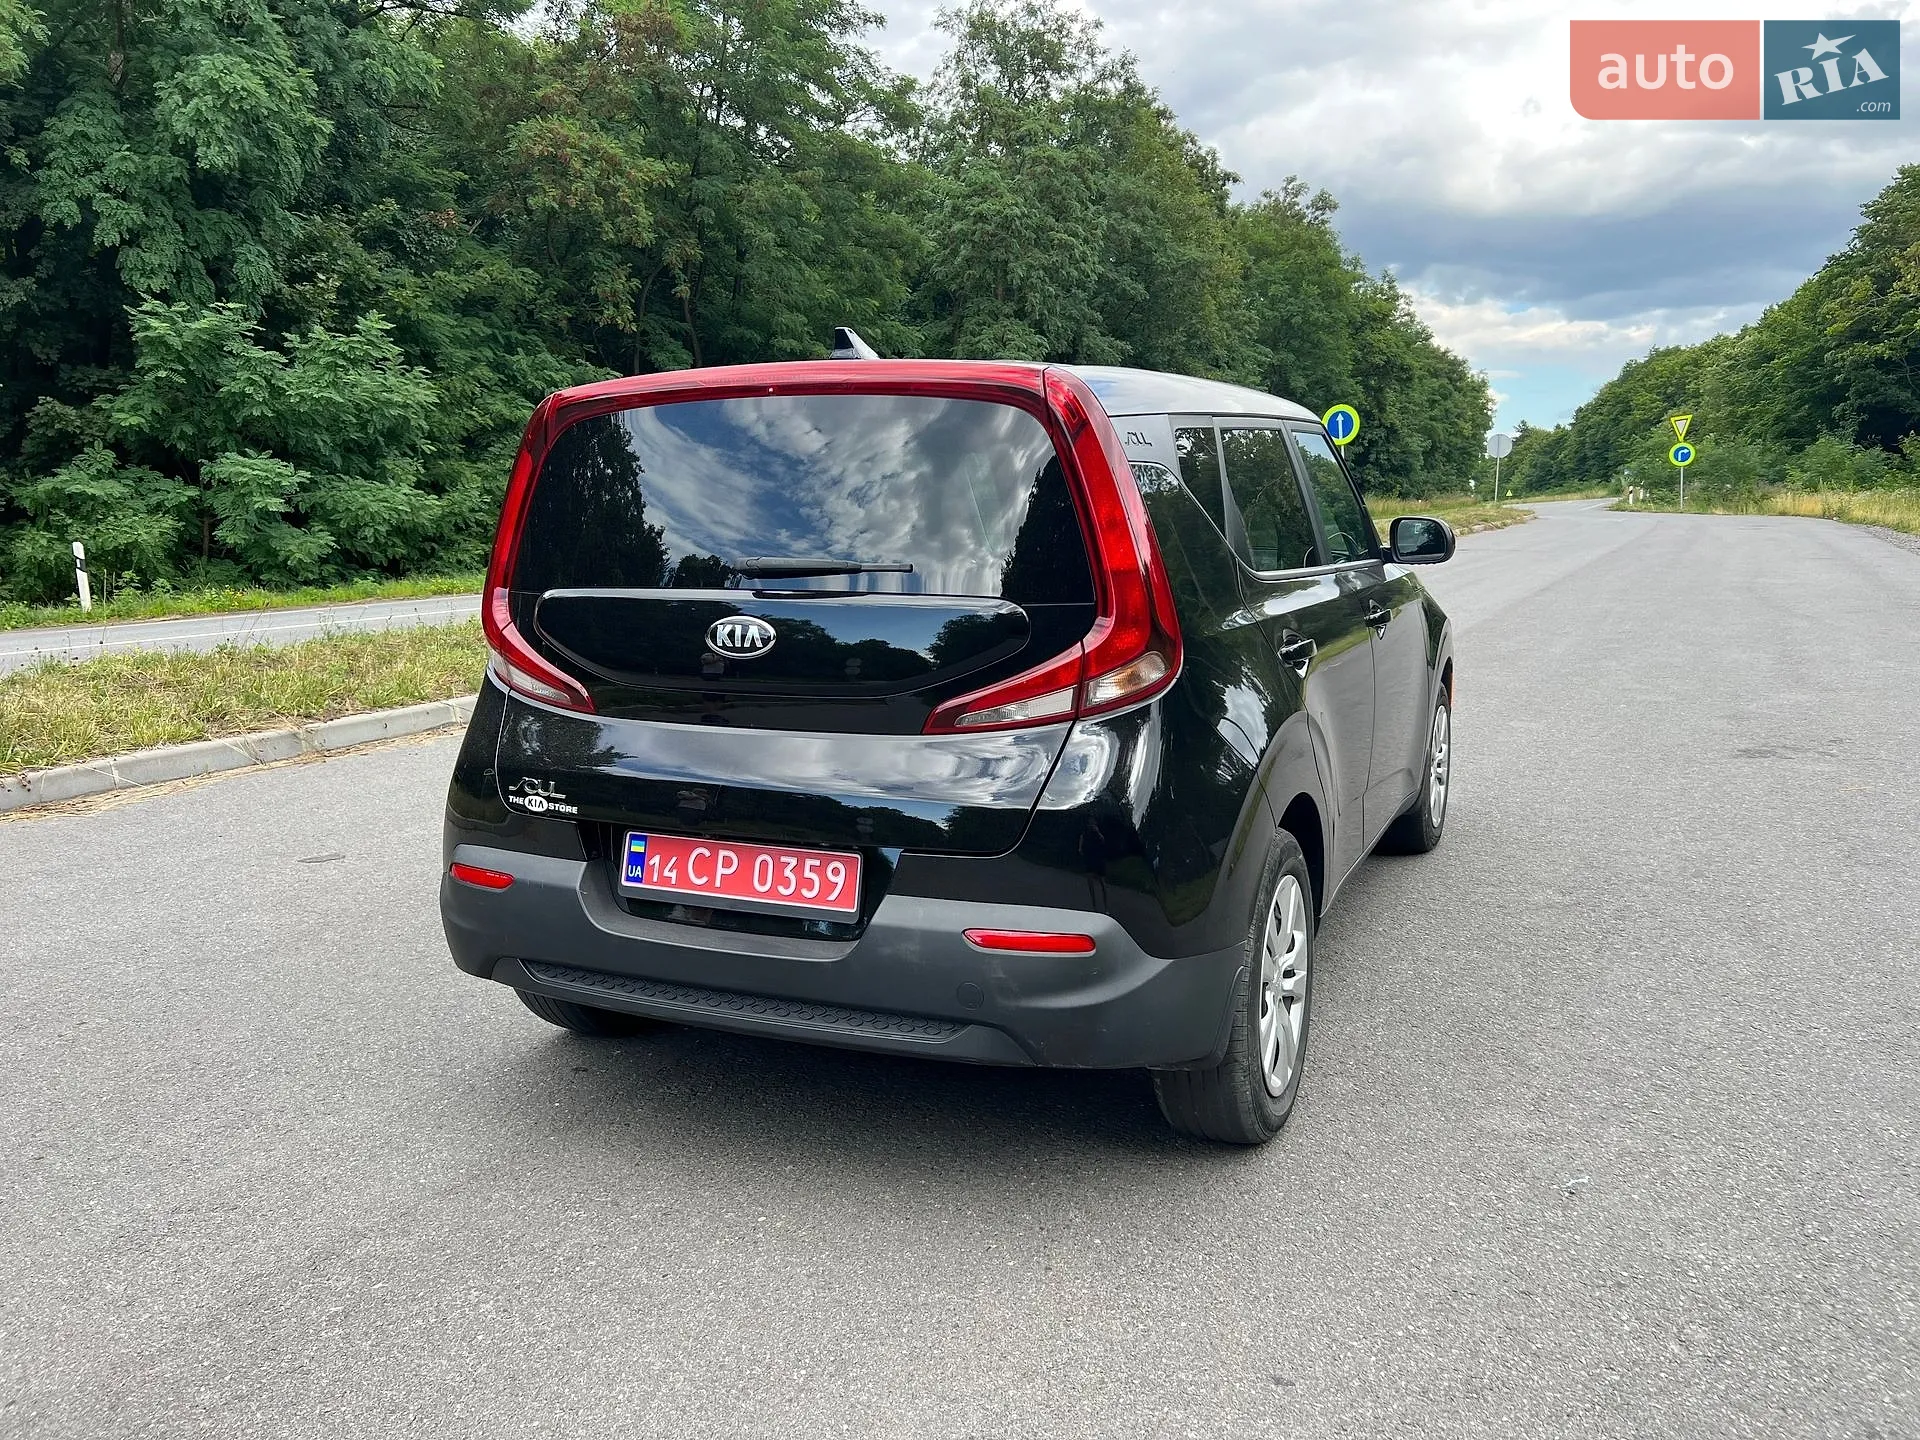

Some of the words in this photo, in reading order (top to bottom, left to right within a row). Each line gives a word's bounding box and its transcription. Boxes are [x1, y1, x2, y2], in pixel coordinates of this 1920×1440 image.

[716, 624, 764, 648] KIA
[508, 795, 525, 805] THE
[548, 802, 578, 814] STORE
[627, 864, 643, 879] UA
[648, 854, 678, 885] 14
[687, 846, 740, 888] CP
[752, 853, 847, 901] 0359
